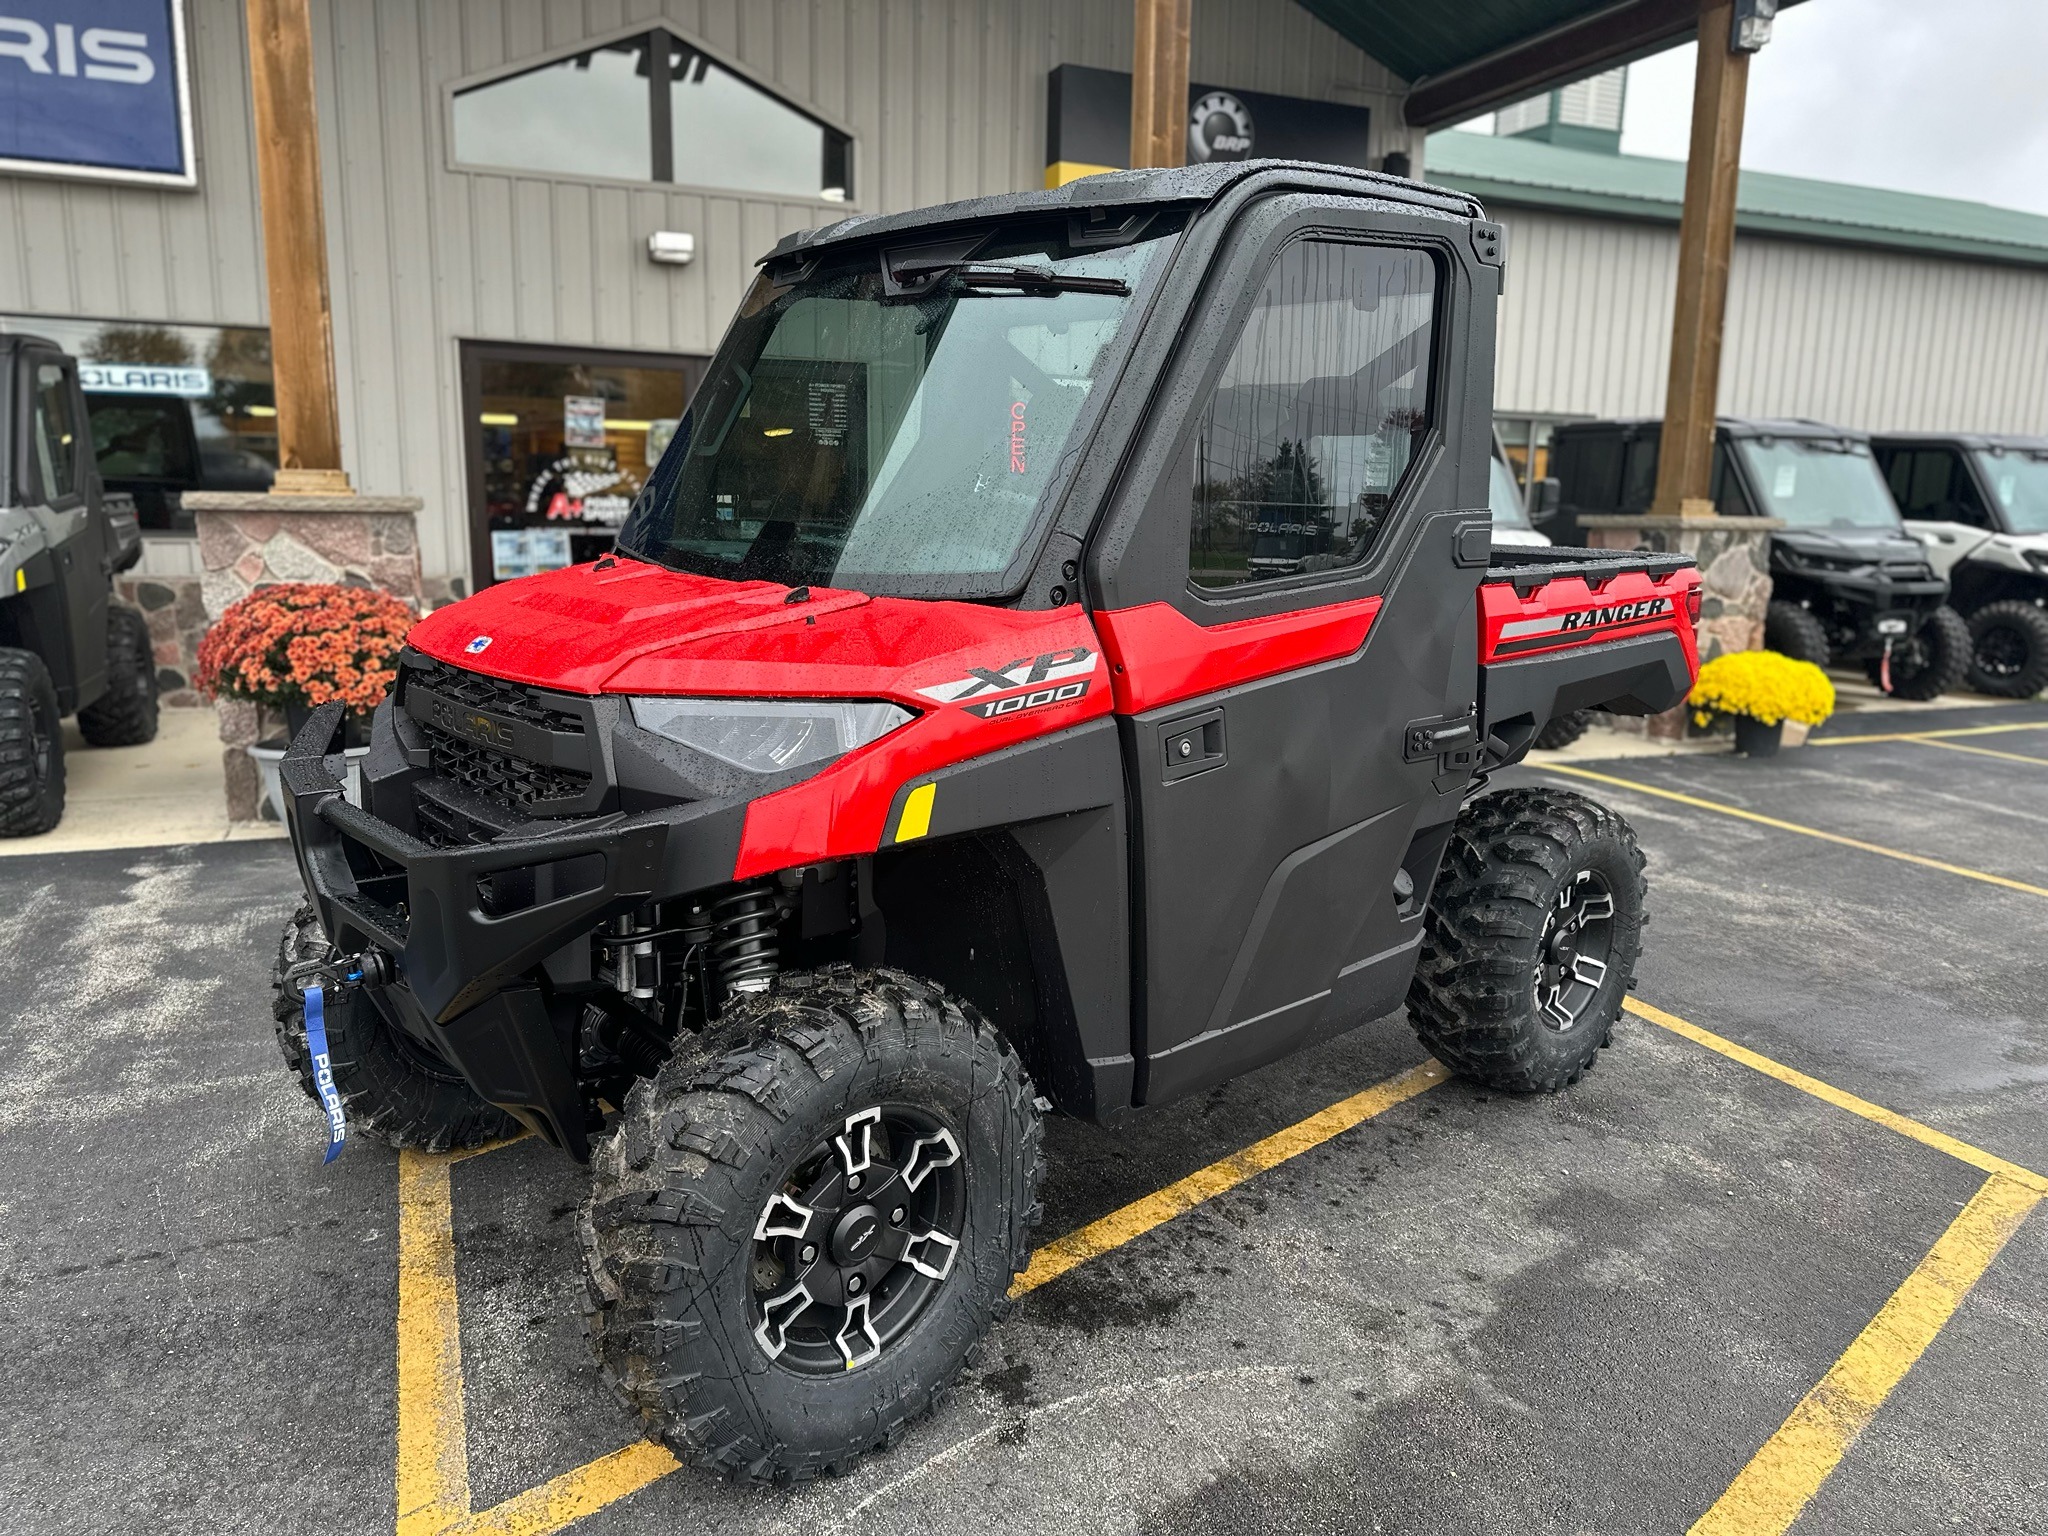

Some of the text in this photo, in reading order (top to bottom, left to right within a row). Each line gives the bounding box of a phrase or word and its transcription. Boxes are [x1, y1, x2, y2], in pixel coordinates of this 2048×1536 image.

[1248, 521, 1318, 536] POLARIS
[1560, 598, 1666, 632] RANGER
[950, 646, 1093, 700] XP
[985, 683, 1083, 718] 1000
[989, 699, 1085, 725] DUAL OVERHEAD CAM
[432, 699, 515, 750] POLARIS
[315, 1053, 345, 1143] POLARIS
